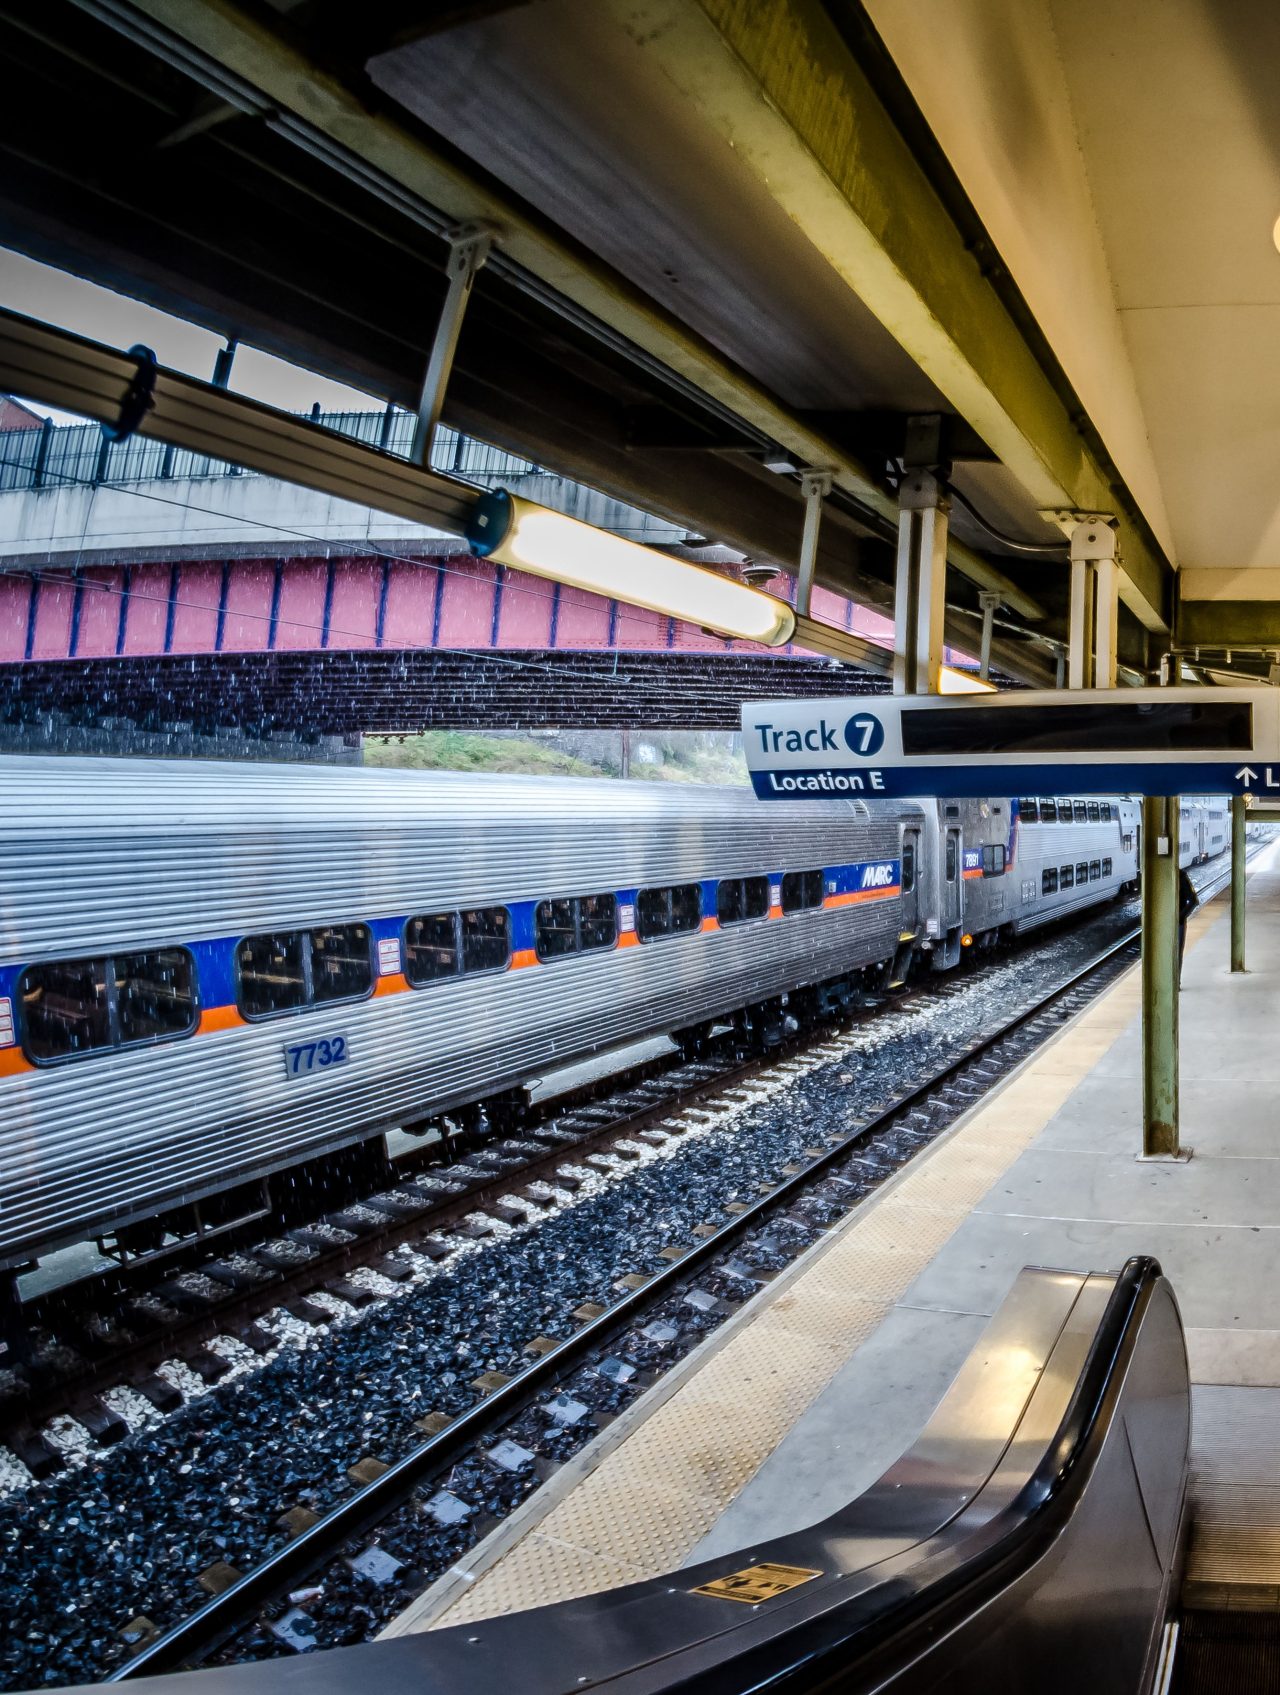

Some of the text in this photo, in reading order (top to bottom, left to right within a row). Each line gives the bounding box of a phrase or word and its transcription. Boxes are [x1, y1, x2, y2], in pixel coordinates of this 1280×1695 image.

[754, 719, 875, 753] Track 7
[769, 771, 886, 791] Location E
[861, 864, 894, 888] MARC
[287, 1036, 346, 1073] 7732
